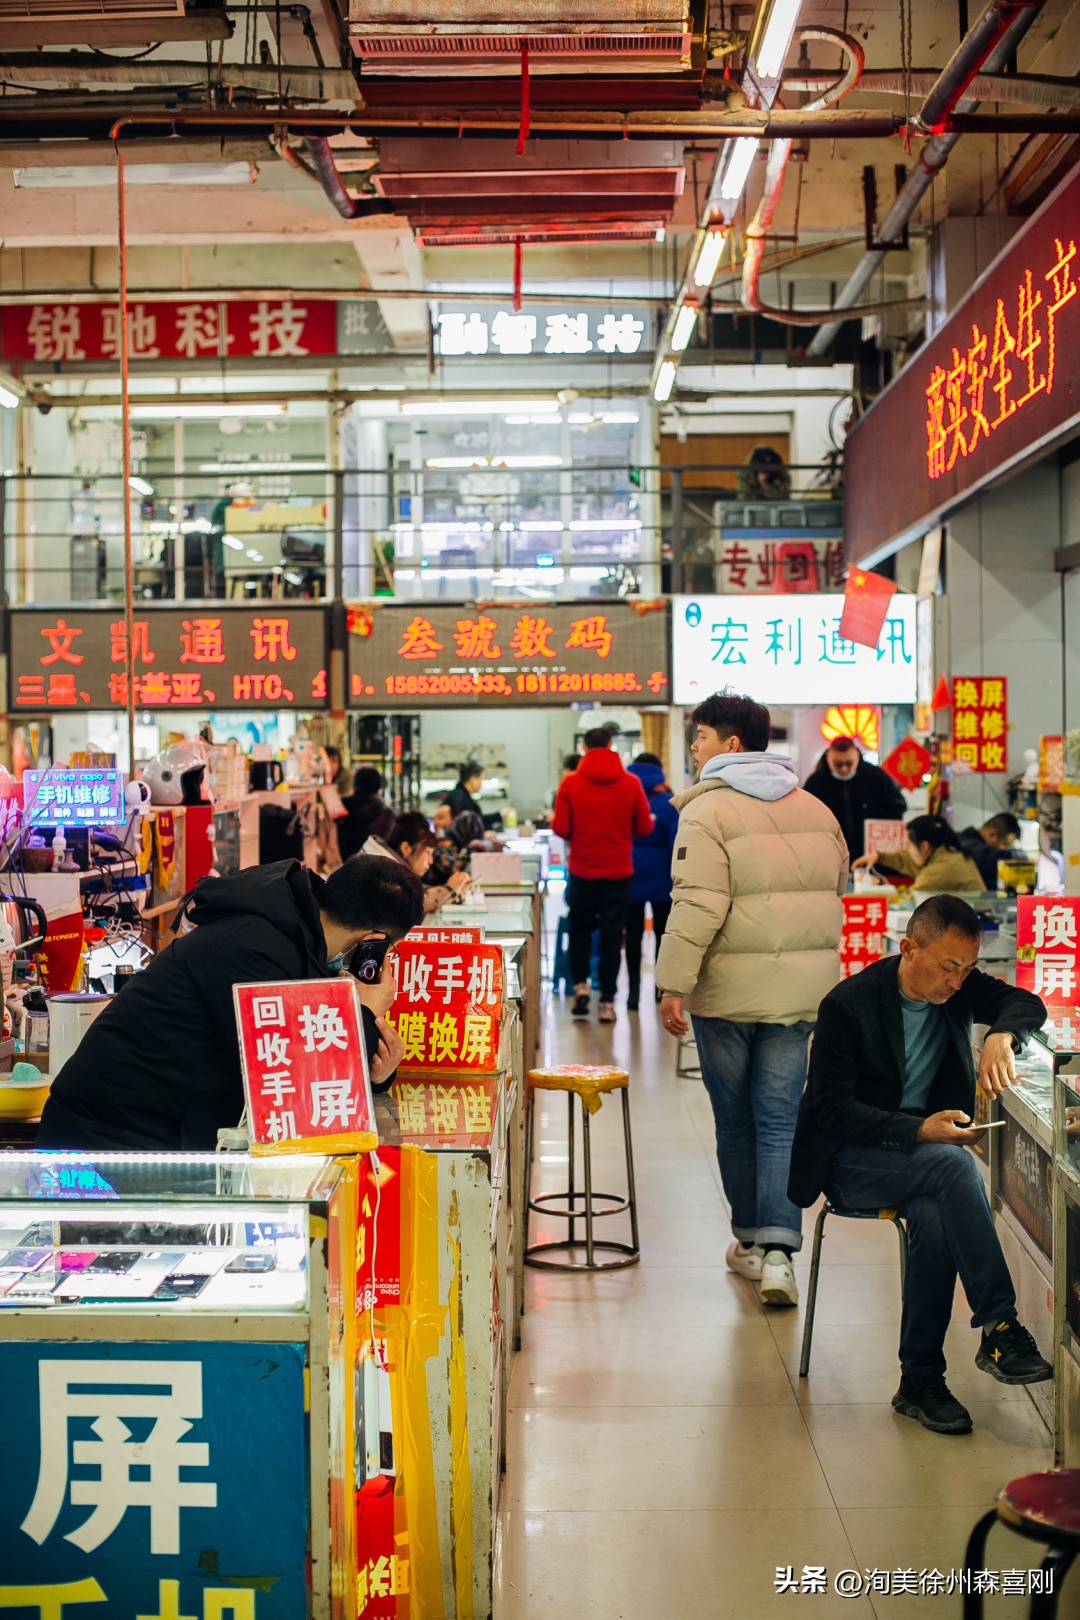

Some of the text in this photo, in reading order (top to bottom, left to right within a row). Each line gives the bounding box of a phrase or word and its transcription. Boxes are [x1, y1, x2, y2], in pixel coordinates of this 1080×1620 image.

[26, 304, 310, 361] 锐驰科技
[40, 618, 297, 666] 文凯通讯
[398, 614, 613, 660] 叁號数码
[710, 616, 912, 665] 宏利通讯
[955, 679, 1004, 708] 换屏
[955, 711, 1004, 739] 维修
[956, 741, 1004, 770] 回收
[37, 784, 111, 805] 手机维修
[843, 902, 883, 927] 二手
[1032, 905, 1077, 998] 换屏
[252, 996, 302, 1142] 回收手机
[298, 1004, 357, 1128] 换屏
[20, 1359, 217, 1554] 屏
